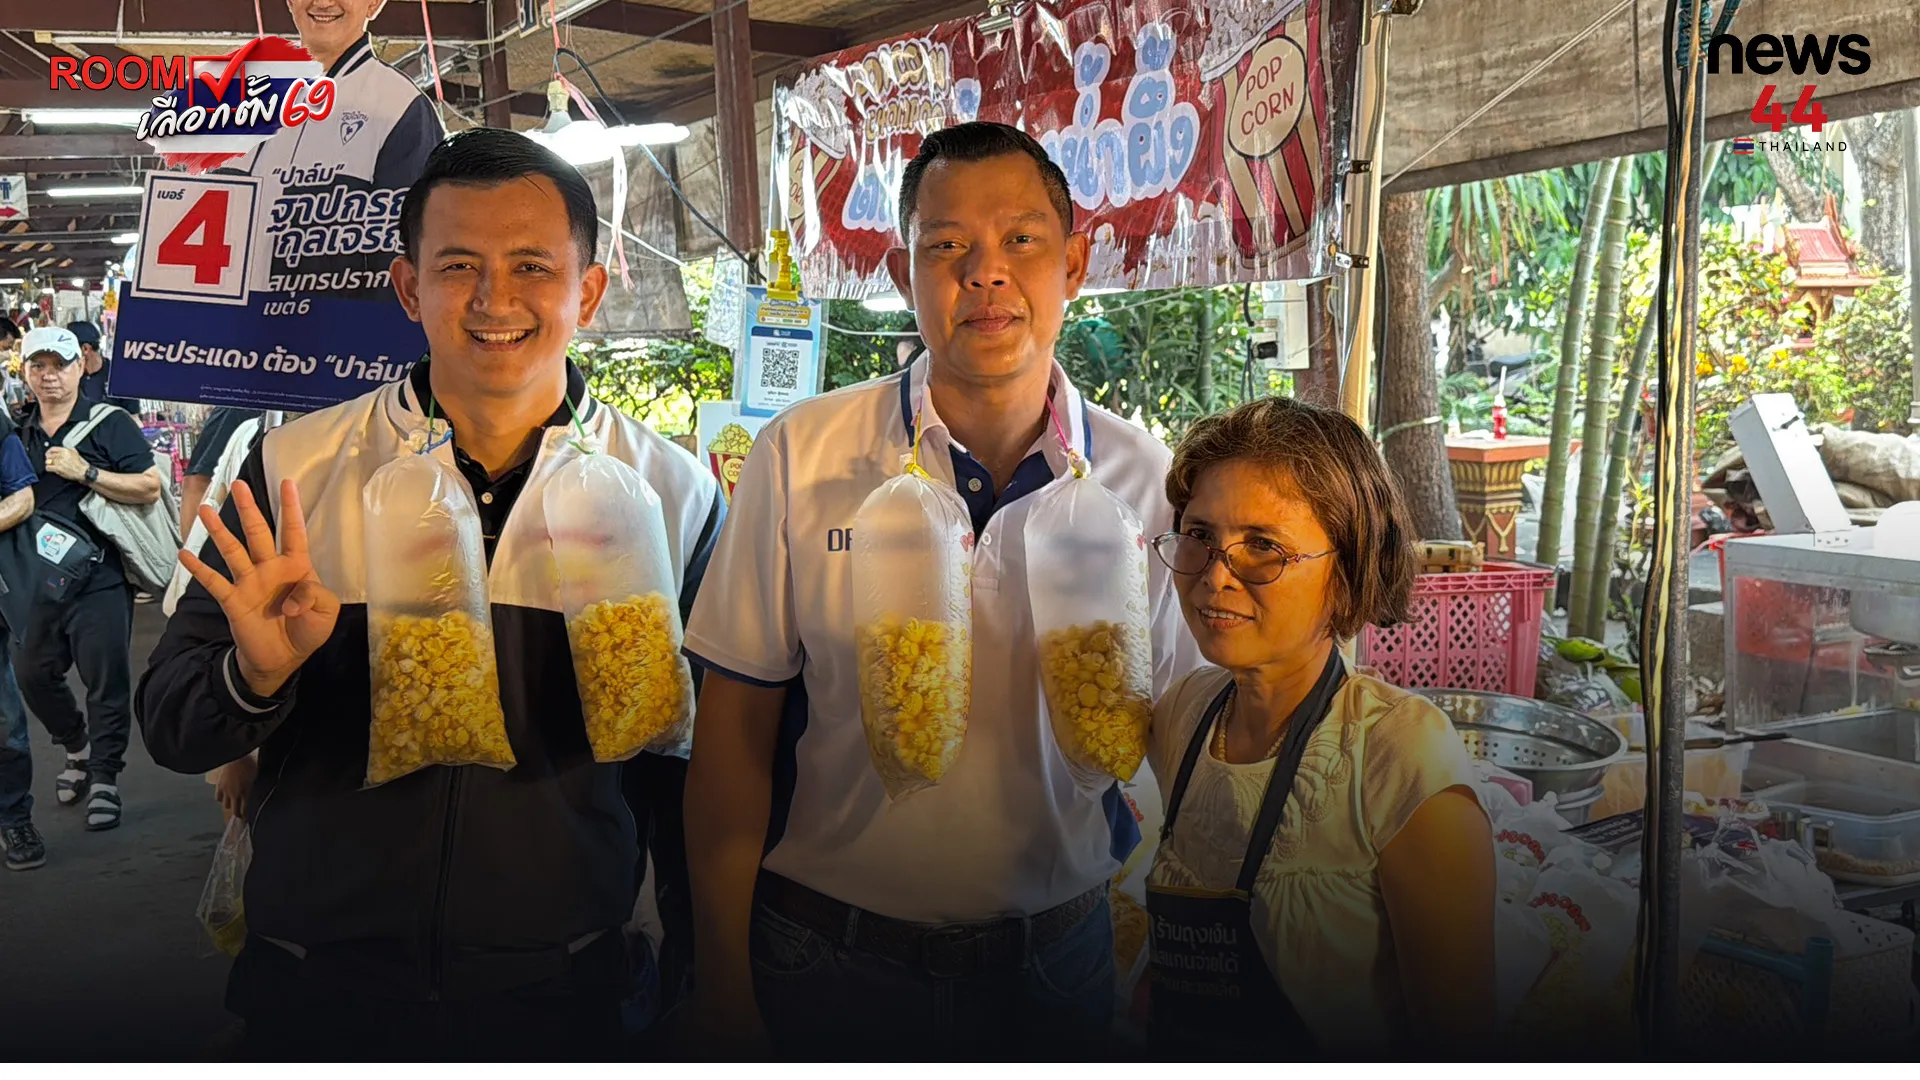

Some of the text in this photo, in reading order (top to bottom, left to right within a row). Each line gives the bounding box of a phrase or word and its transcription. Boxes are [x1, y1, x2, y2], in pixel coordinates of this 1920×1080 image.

[1246, 56, 1282, 101] POP
[1241, 82, 1294, 136] CORN
[157, 188, 186, 201] เบอร์
[157, 189, 232, 285] 4
[268, 268, 391, 298] สมุทรปราก
[263, 299, 311, 316] เขต 6
[122, 339, 259, 370] พระประแดง
[262, 345, 318, 375] ต้อง
[1156, 914, 1238, 950] ร้านถุงเงิน
